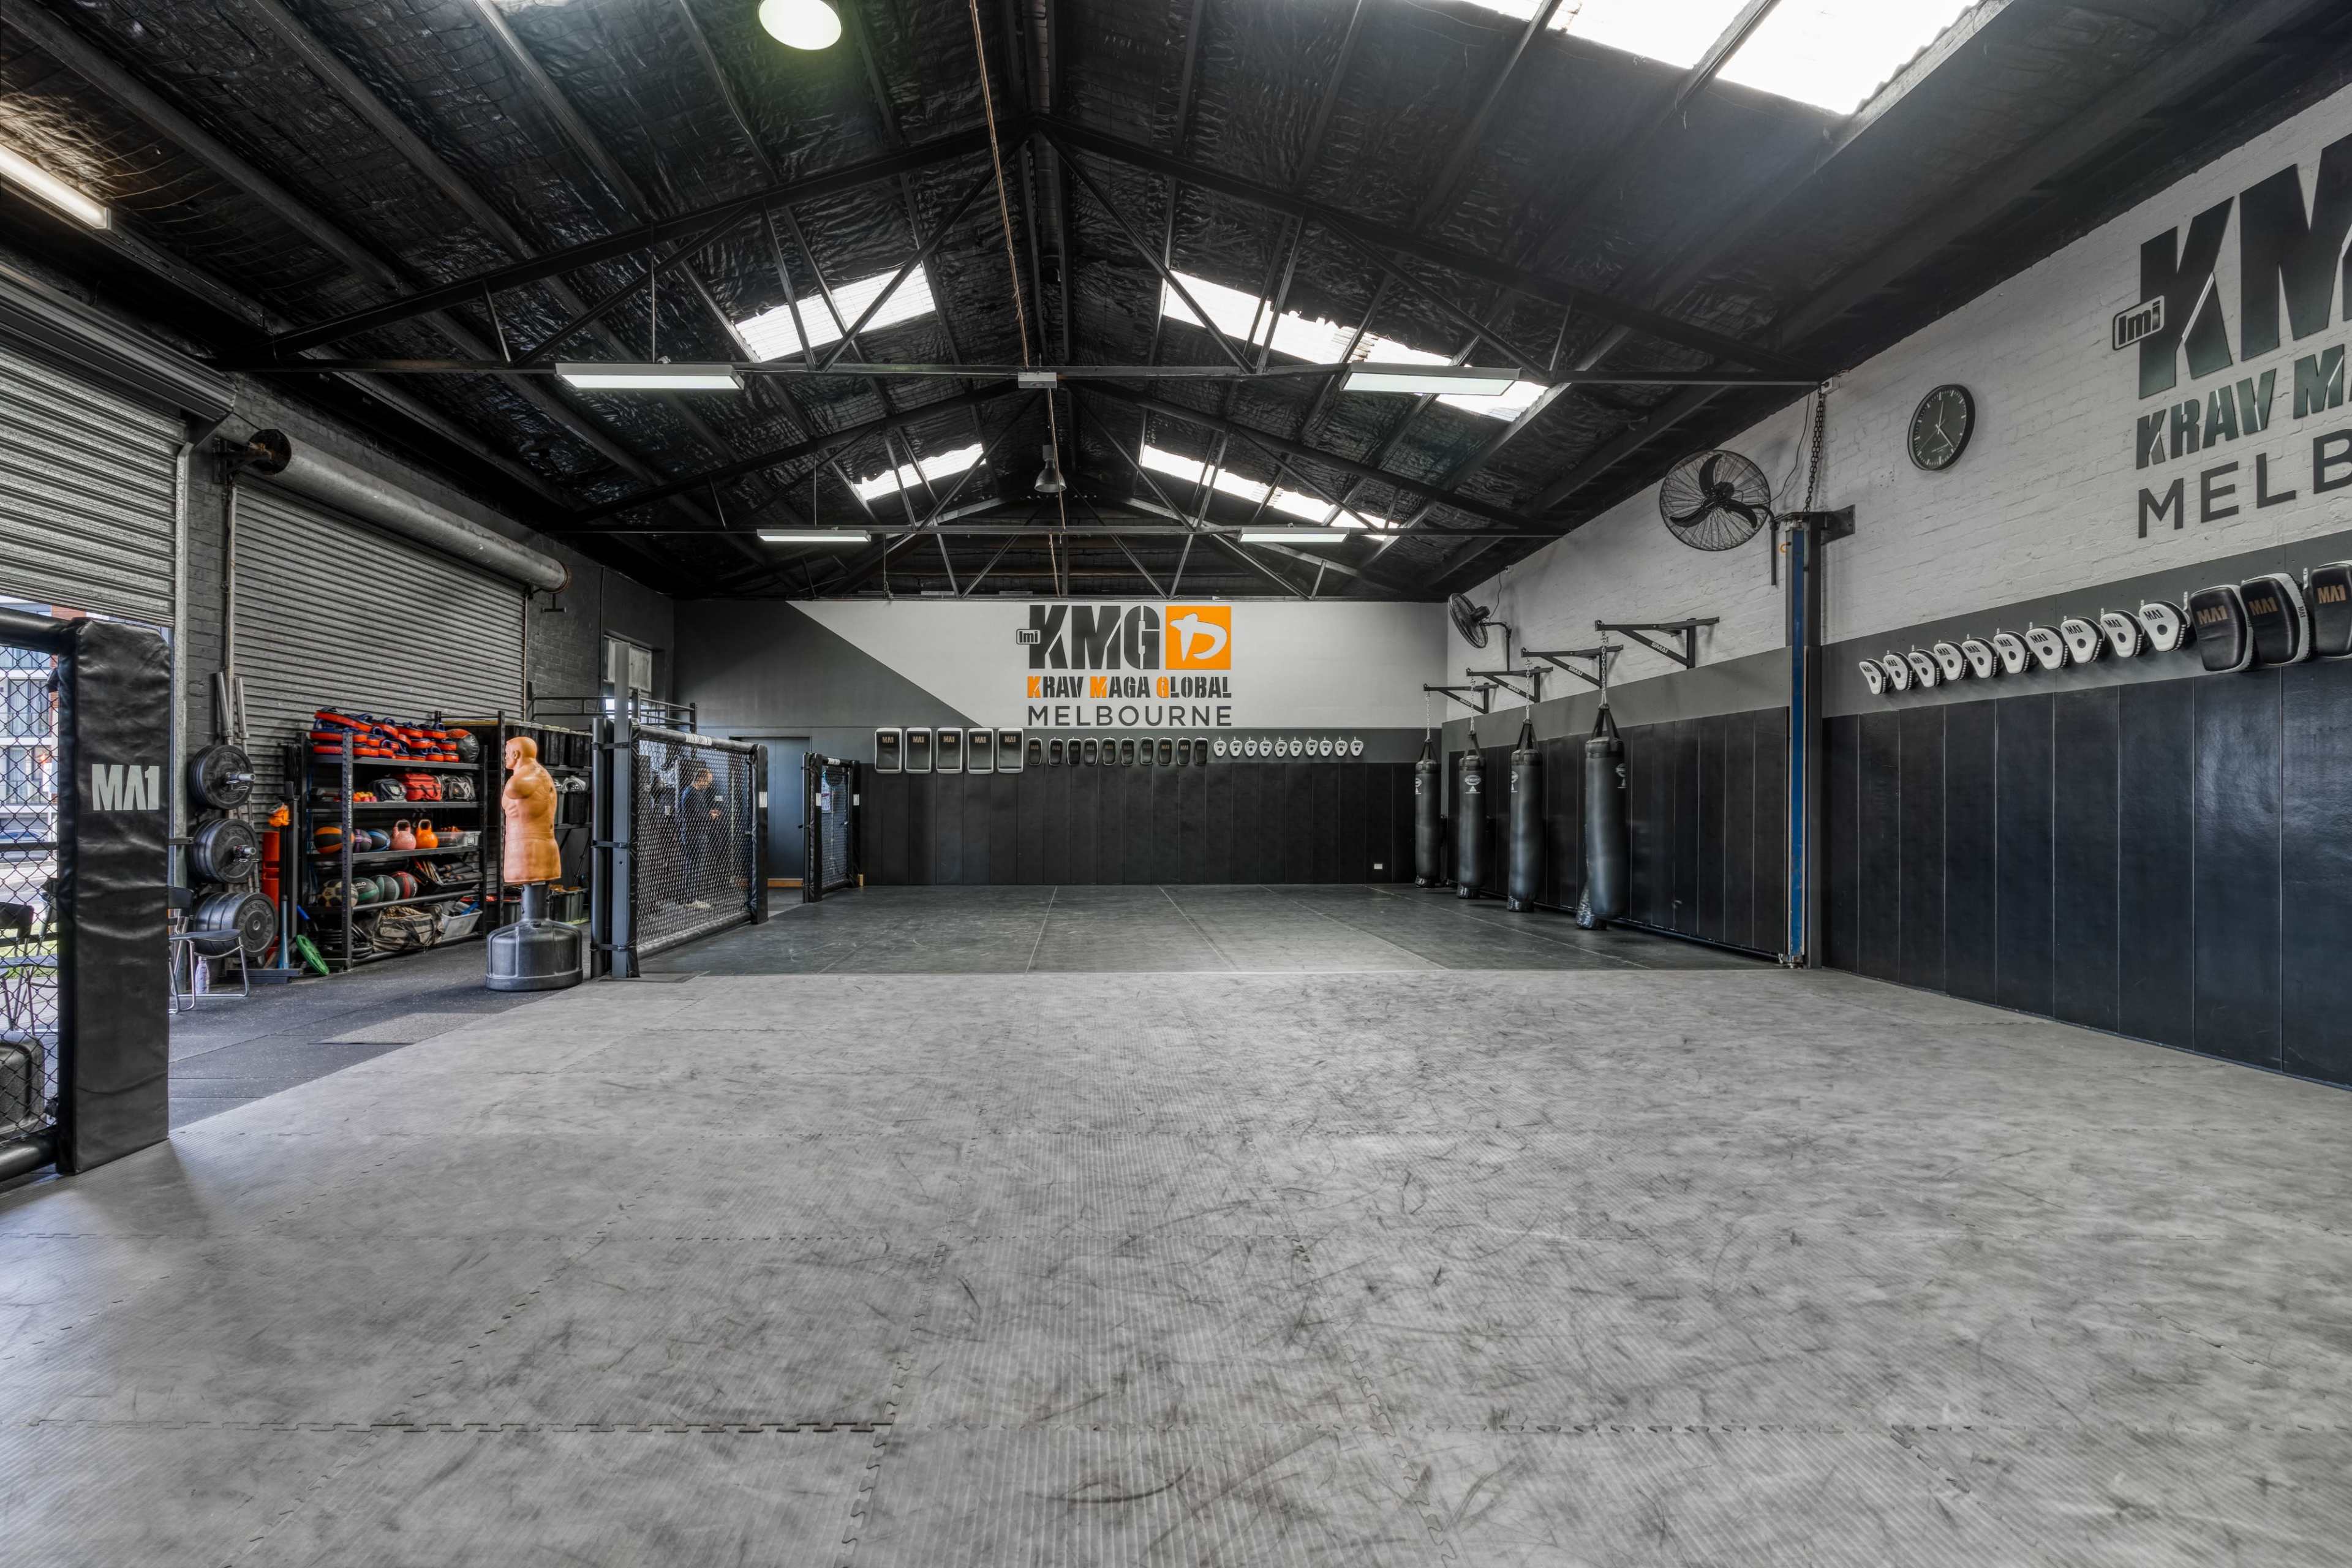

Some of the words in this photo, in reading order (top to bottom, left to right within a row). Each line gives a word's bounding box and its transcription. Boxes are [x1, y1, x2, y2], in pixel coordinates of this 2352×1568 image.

[2118, 301, 2161, 345] Imi
[2136, 368, 2277, 470] KRAV
[2293, 344, 2352, 420] M
[2317, 584, 2347, 604] MA1
[2143, 609, 2164, 620] MA1
[2196, 605, 2229, 625] MA1
[2248, 597, 2278, 616] MA1
[2297, 606, 2306, 618] MA1
[2065, 625, 2083, 635] MA1
[2104, 619, 2122, 628] MA1
[1019, 631, 1038, 643] Imi
[1029, 605, 1159, 669] KMG
[2030, 633, 2049, 643] MA1
[1965, 645, 1980, 654] MA1
[1027, 676, 1084, 698] KRAV
[1090, 676, 1150, 698] MAGA
[1156, 676, 1232, 698] GLOBAL
[1028, 706, 1232, 726] MELBOURNE
[92, 764, 160, 811] MA1
